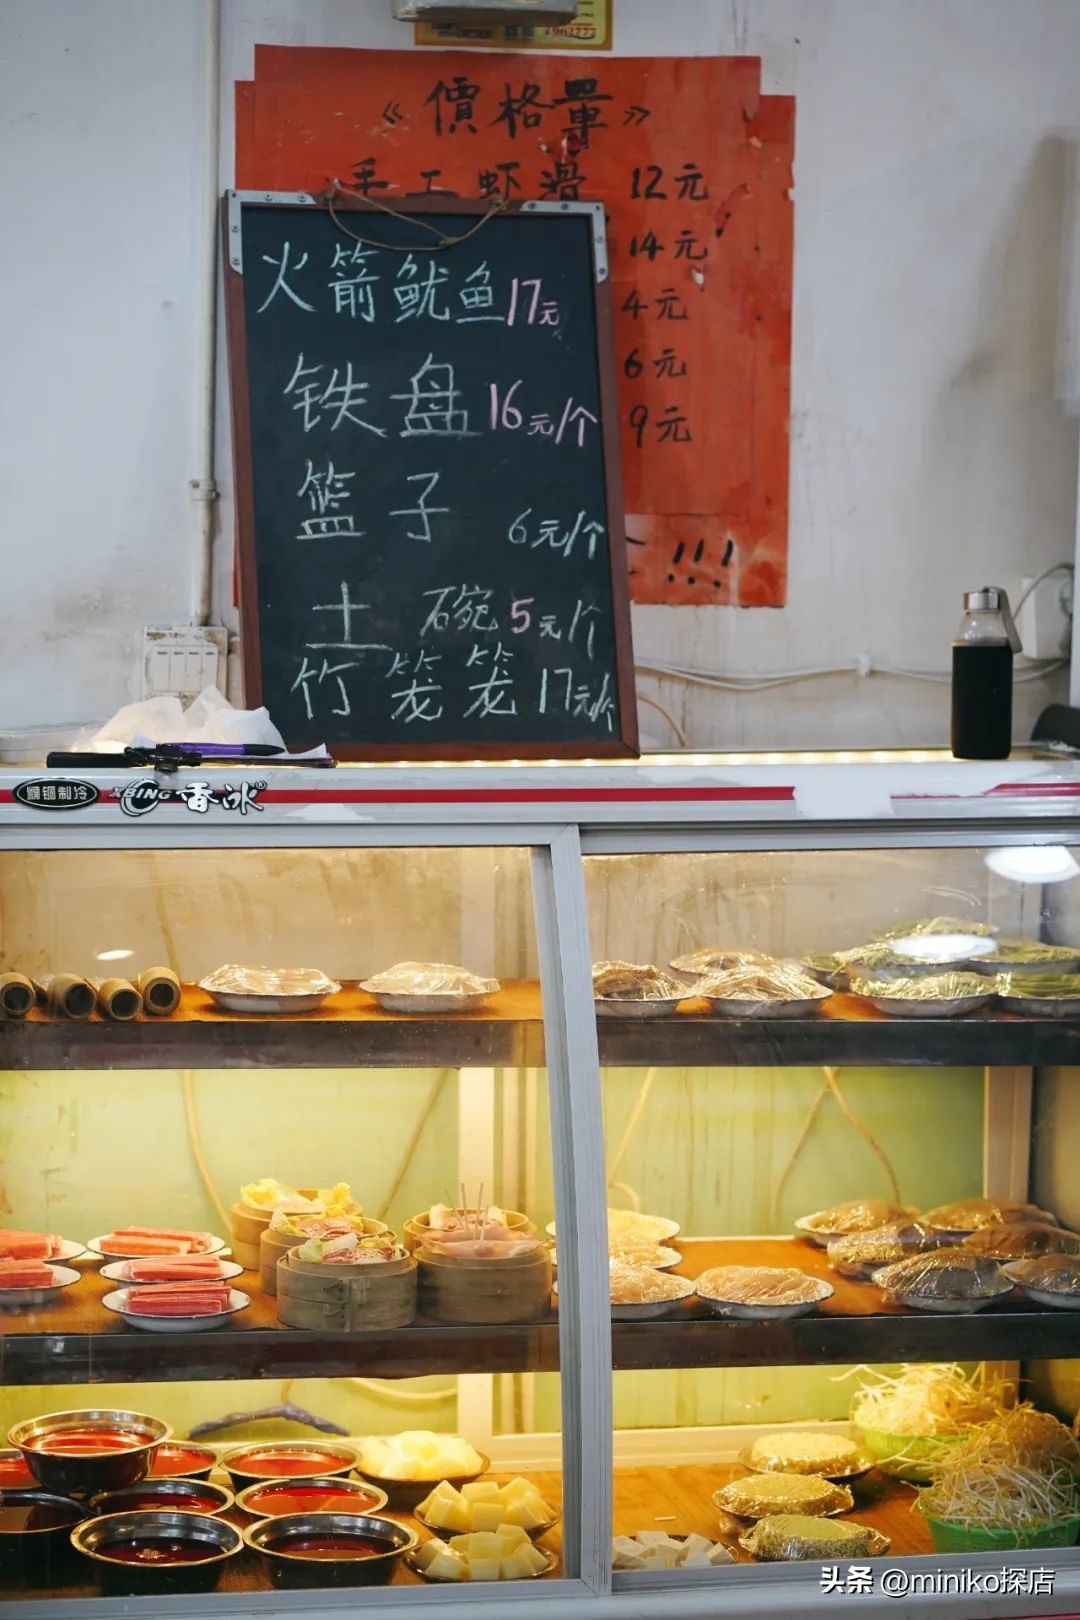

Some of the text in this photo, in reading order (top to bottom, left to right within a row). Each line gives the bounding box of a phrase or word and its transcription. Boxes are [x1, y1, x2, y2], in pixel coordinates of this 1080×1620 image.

[630, 163, 710, 201] 12元
[628, 229, 709, 262] 14元
[256, 240, 505, 323] 火箭鱿鱼
[176, 781, 266, 816] 香冰
